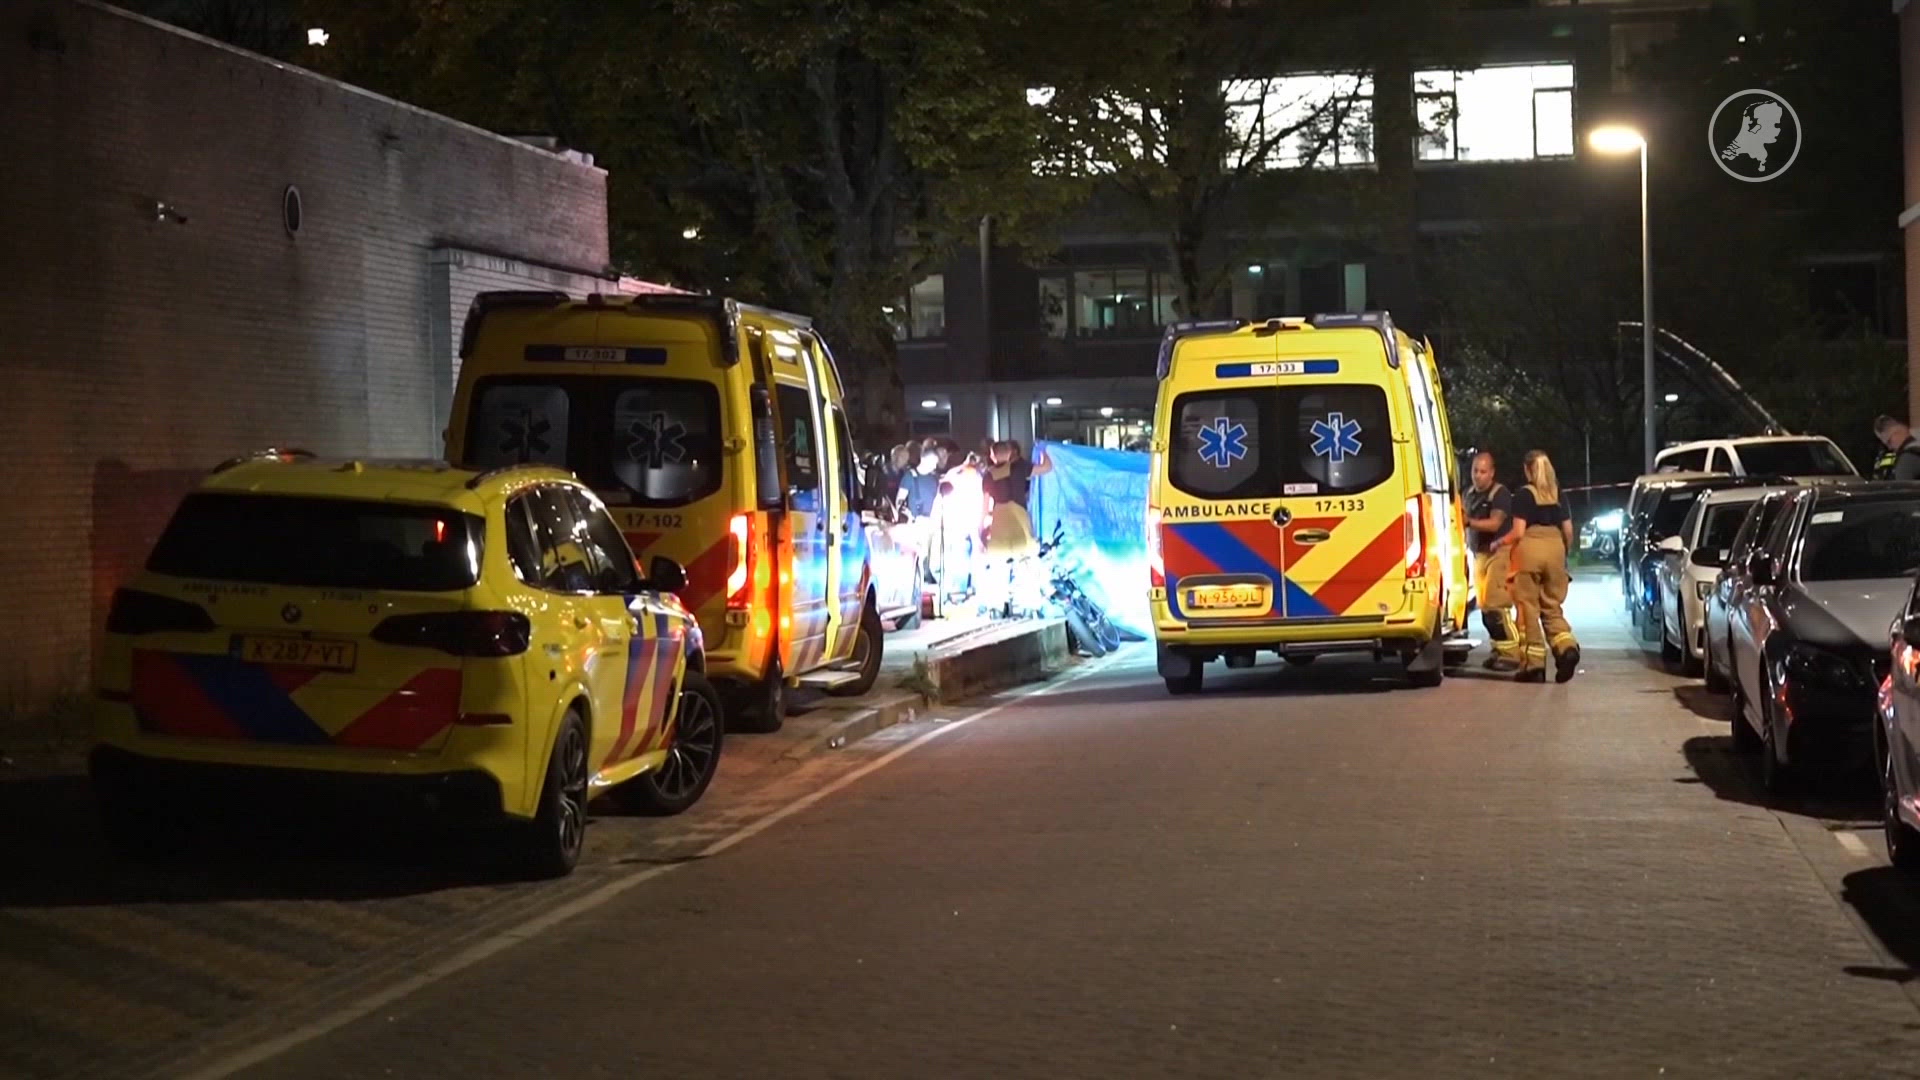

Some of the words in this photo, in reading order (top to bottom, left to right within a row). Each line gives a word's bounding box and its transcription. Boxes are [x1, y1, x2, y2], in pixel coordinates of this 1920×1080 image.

[1260, 364, 1295, 373] 17-133
[1163, 503, 1271, 517] AMBULANCE
[1315, 499, 1365, 512] 17-133
[625, 513, 682, 528] 17-102
[252, 642, 344, 665] X-287-VT
